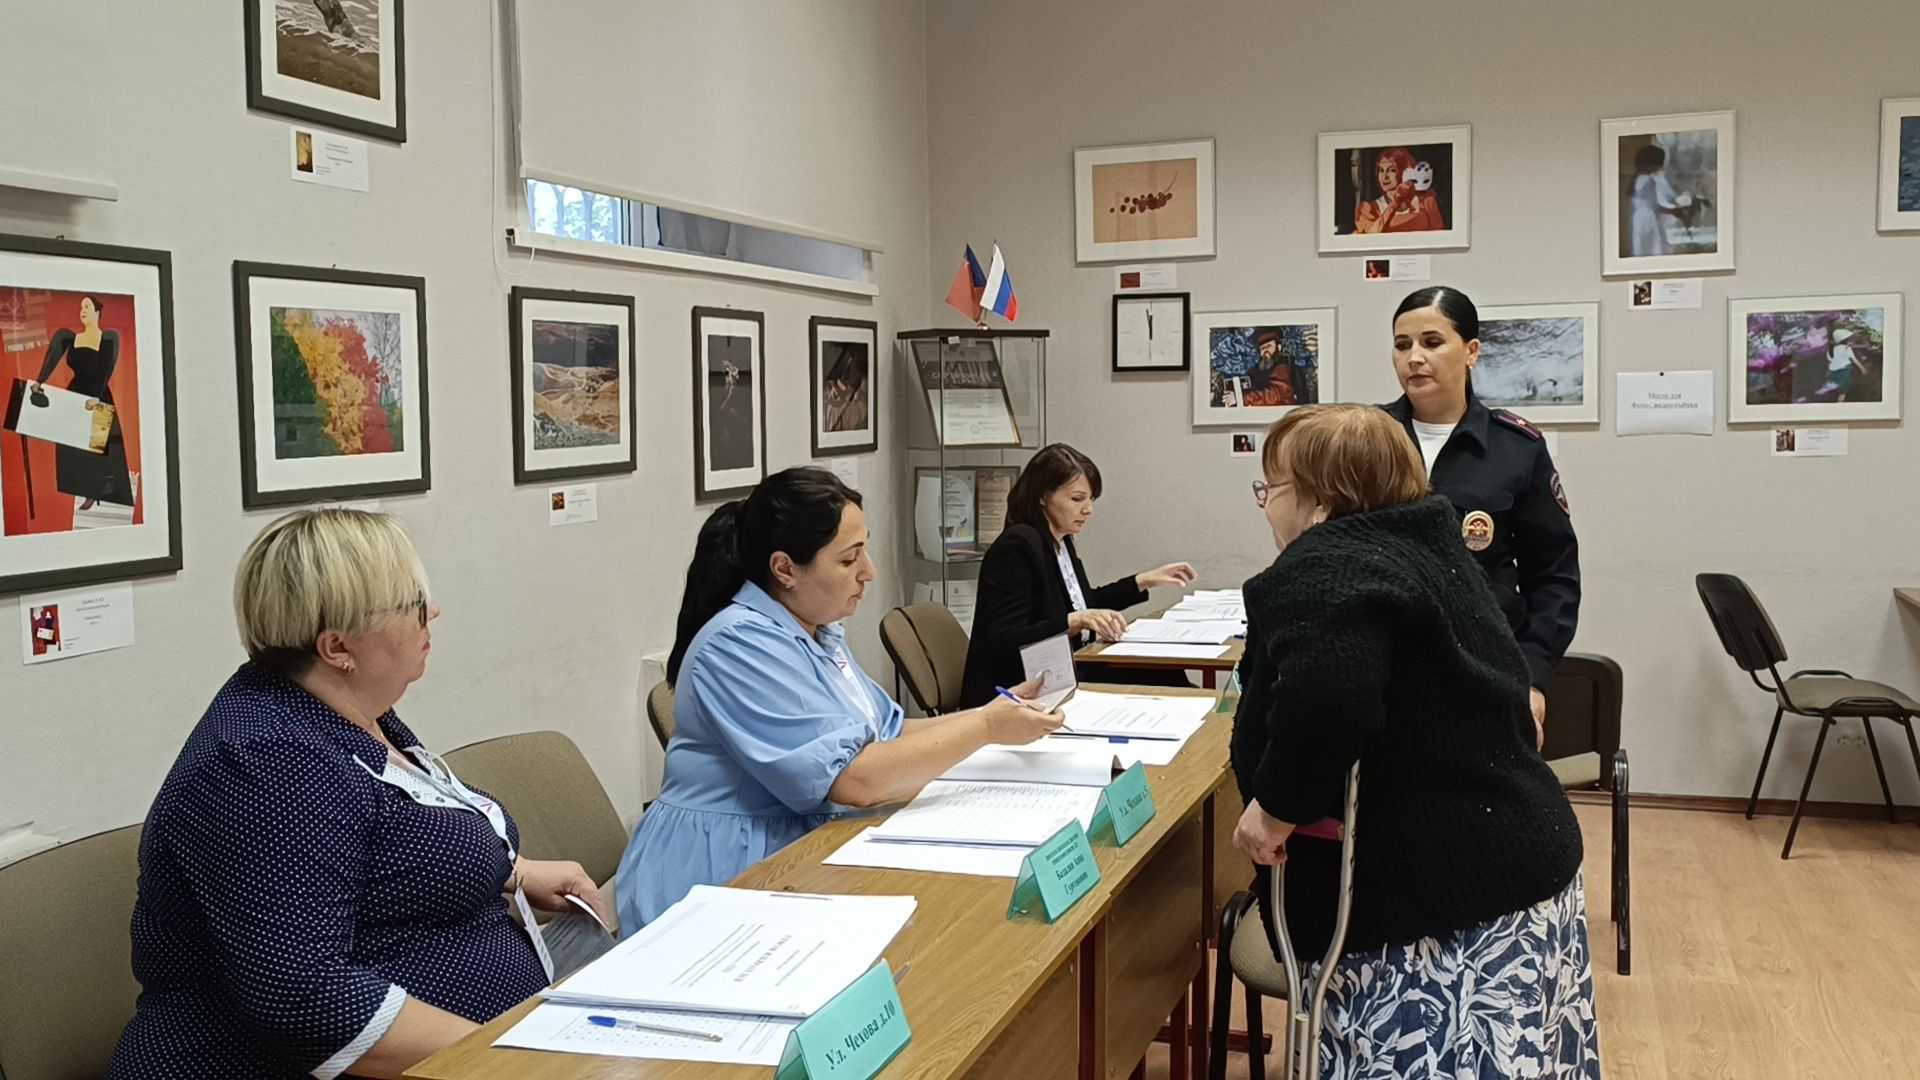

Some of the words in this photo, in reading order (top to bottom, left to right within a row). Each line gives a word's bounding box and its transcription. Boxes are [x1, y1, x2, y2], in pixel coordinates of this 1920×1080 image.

[825, 1049, 847, 1071] Ул.
[844, 1018, 880, 1051] Чехова
[880, 1000, 896, 1028] д.10
